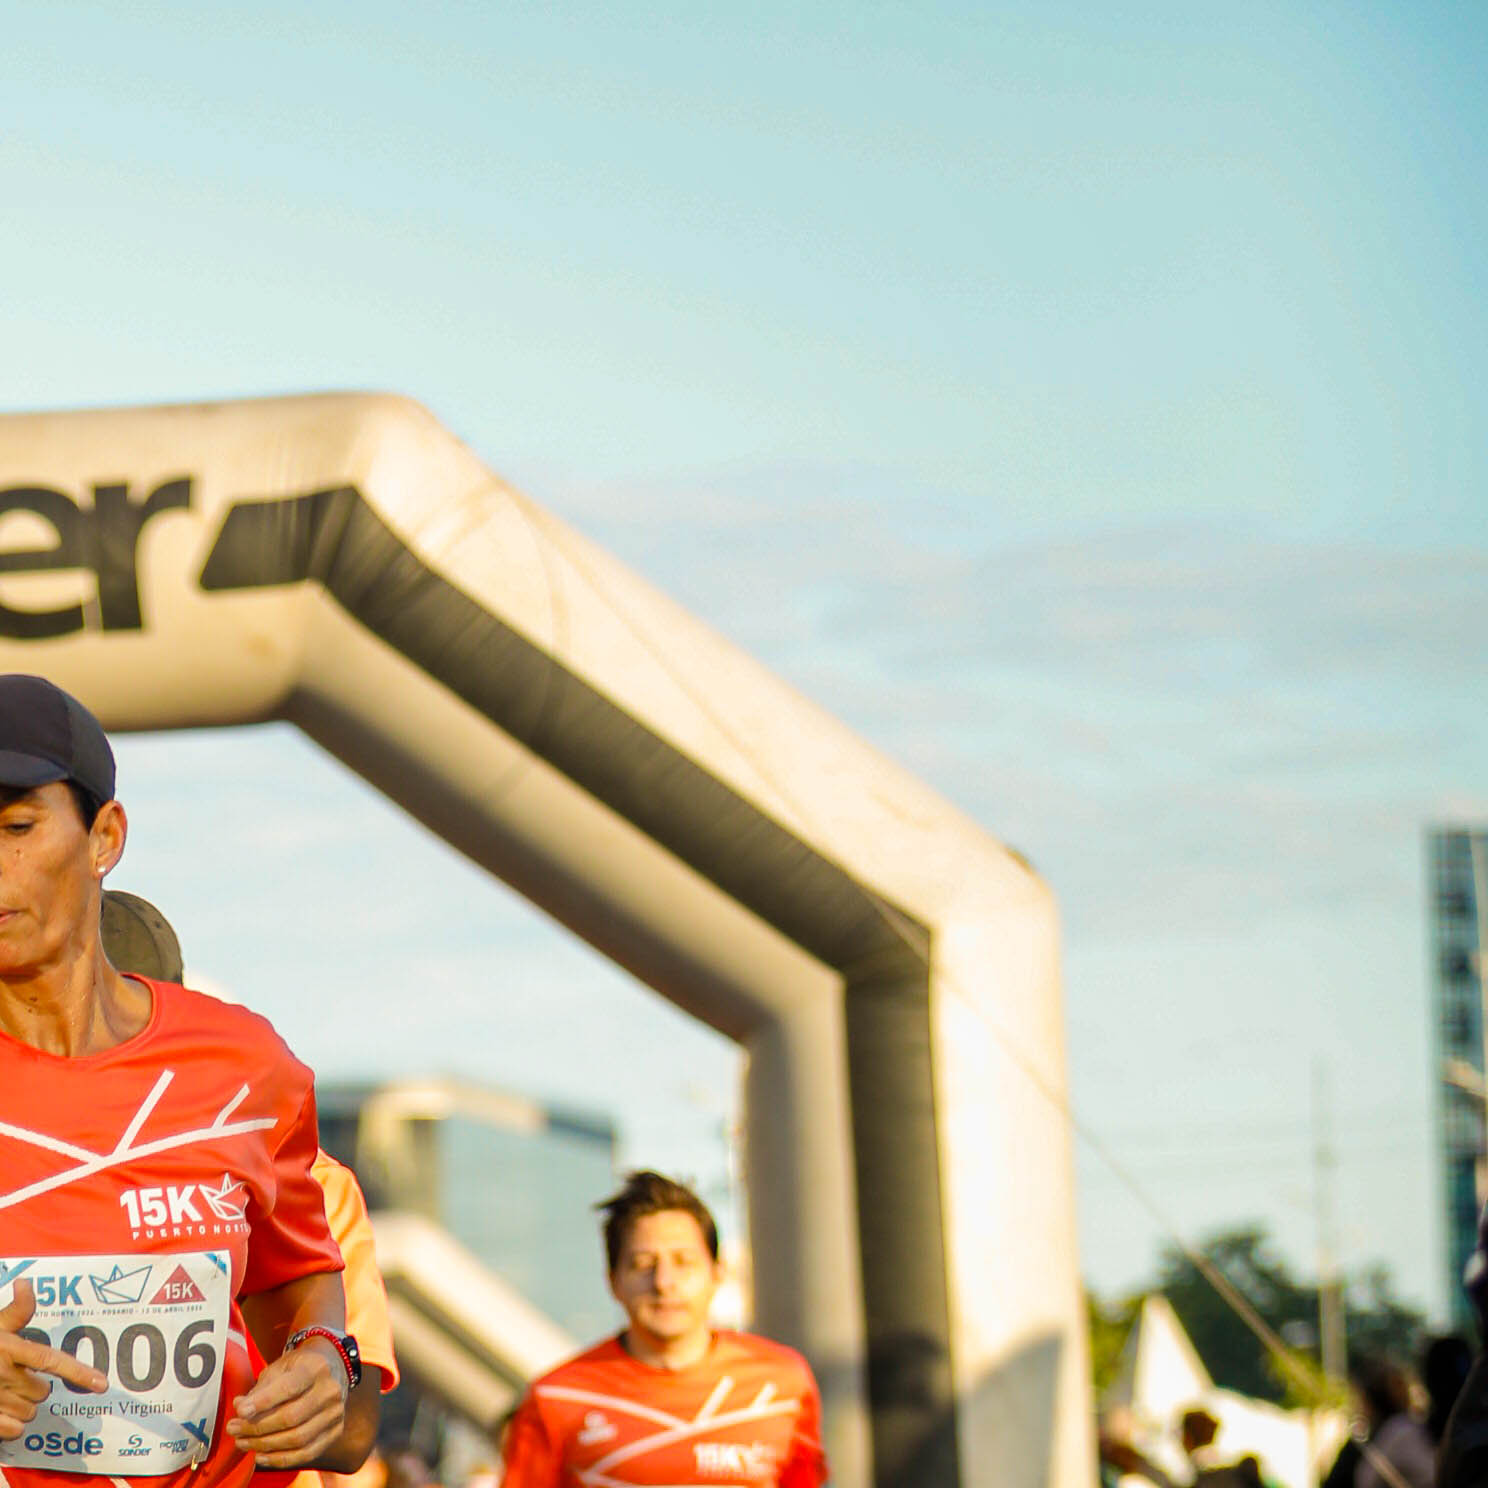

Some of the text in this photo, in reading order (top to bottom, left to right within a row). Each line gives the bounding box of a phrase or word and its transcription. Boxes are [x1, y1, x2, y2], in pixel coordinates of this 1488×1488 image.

[119, 1184, 204, 1229] 15K
[132, 1224, 206, 1240] PUERTO
[28, 1274, 195, 1306] 5K 15K
[17, 1319, 217, 1394] 006
[49, 1400, 174, 1419] Callegari Virginia
[24, 1431, 104, 1457] osde
